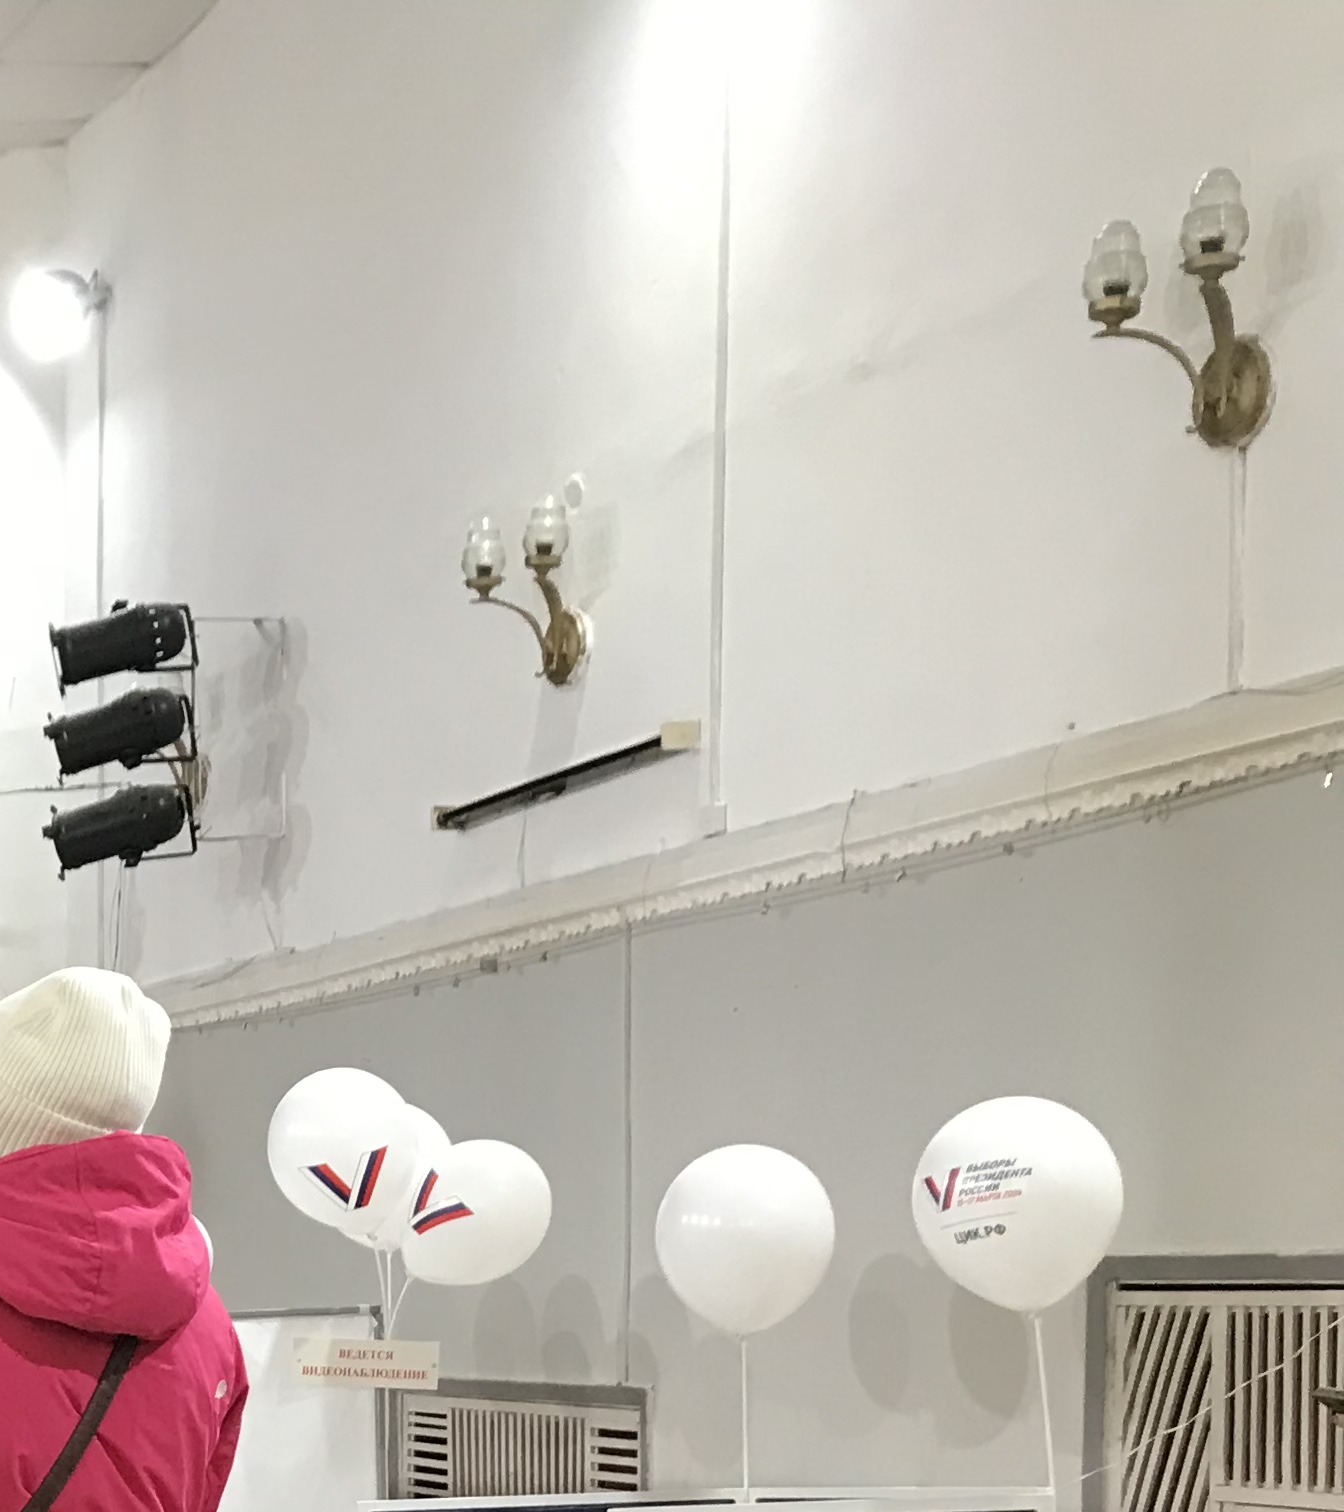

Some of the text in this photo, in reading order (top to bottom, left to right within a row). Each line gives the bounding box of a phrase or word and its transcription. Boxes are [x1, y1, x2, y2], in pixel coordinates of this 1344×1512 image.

[966, 1158, 1018, 1173] ВЫБОРЫ
[963, 1167, 1033, 1184] ПРЕЗИДЕНТА
[959, 1182, 1001, 1197] РОССИИ
[338, 1349, 394, 1360] ВЕДЕТСЯ
[301, 1366, 429, 1380] ВИДЕОНАБЛЮДЕНИЕ
